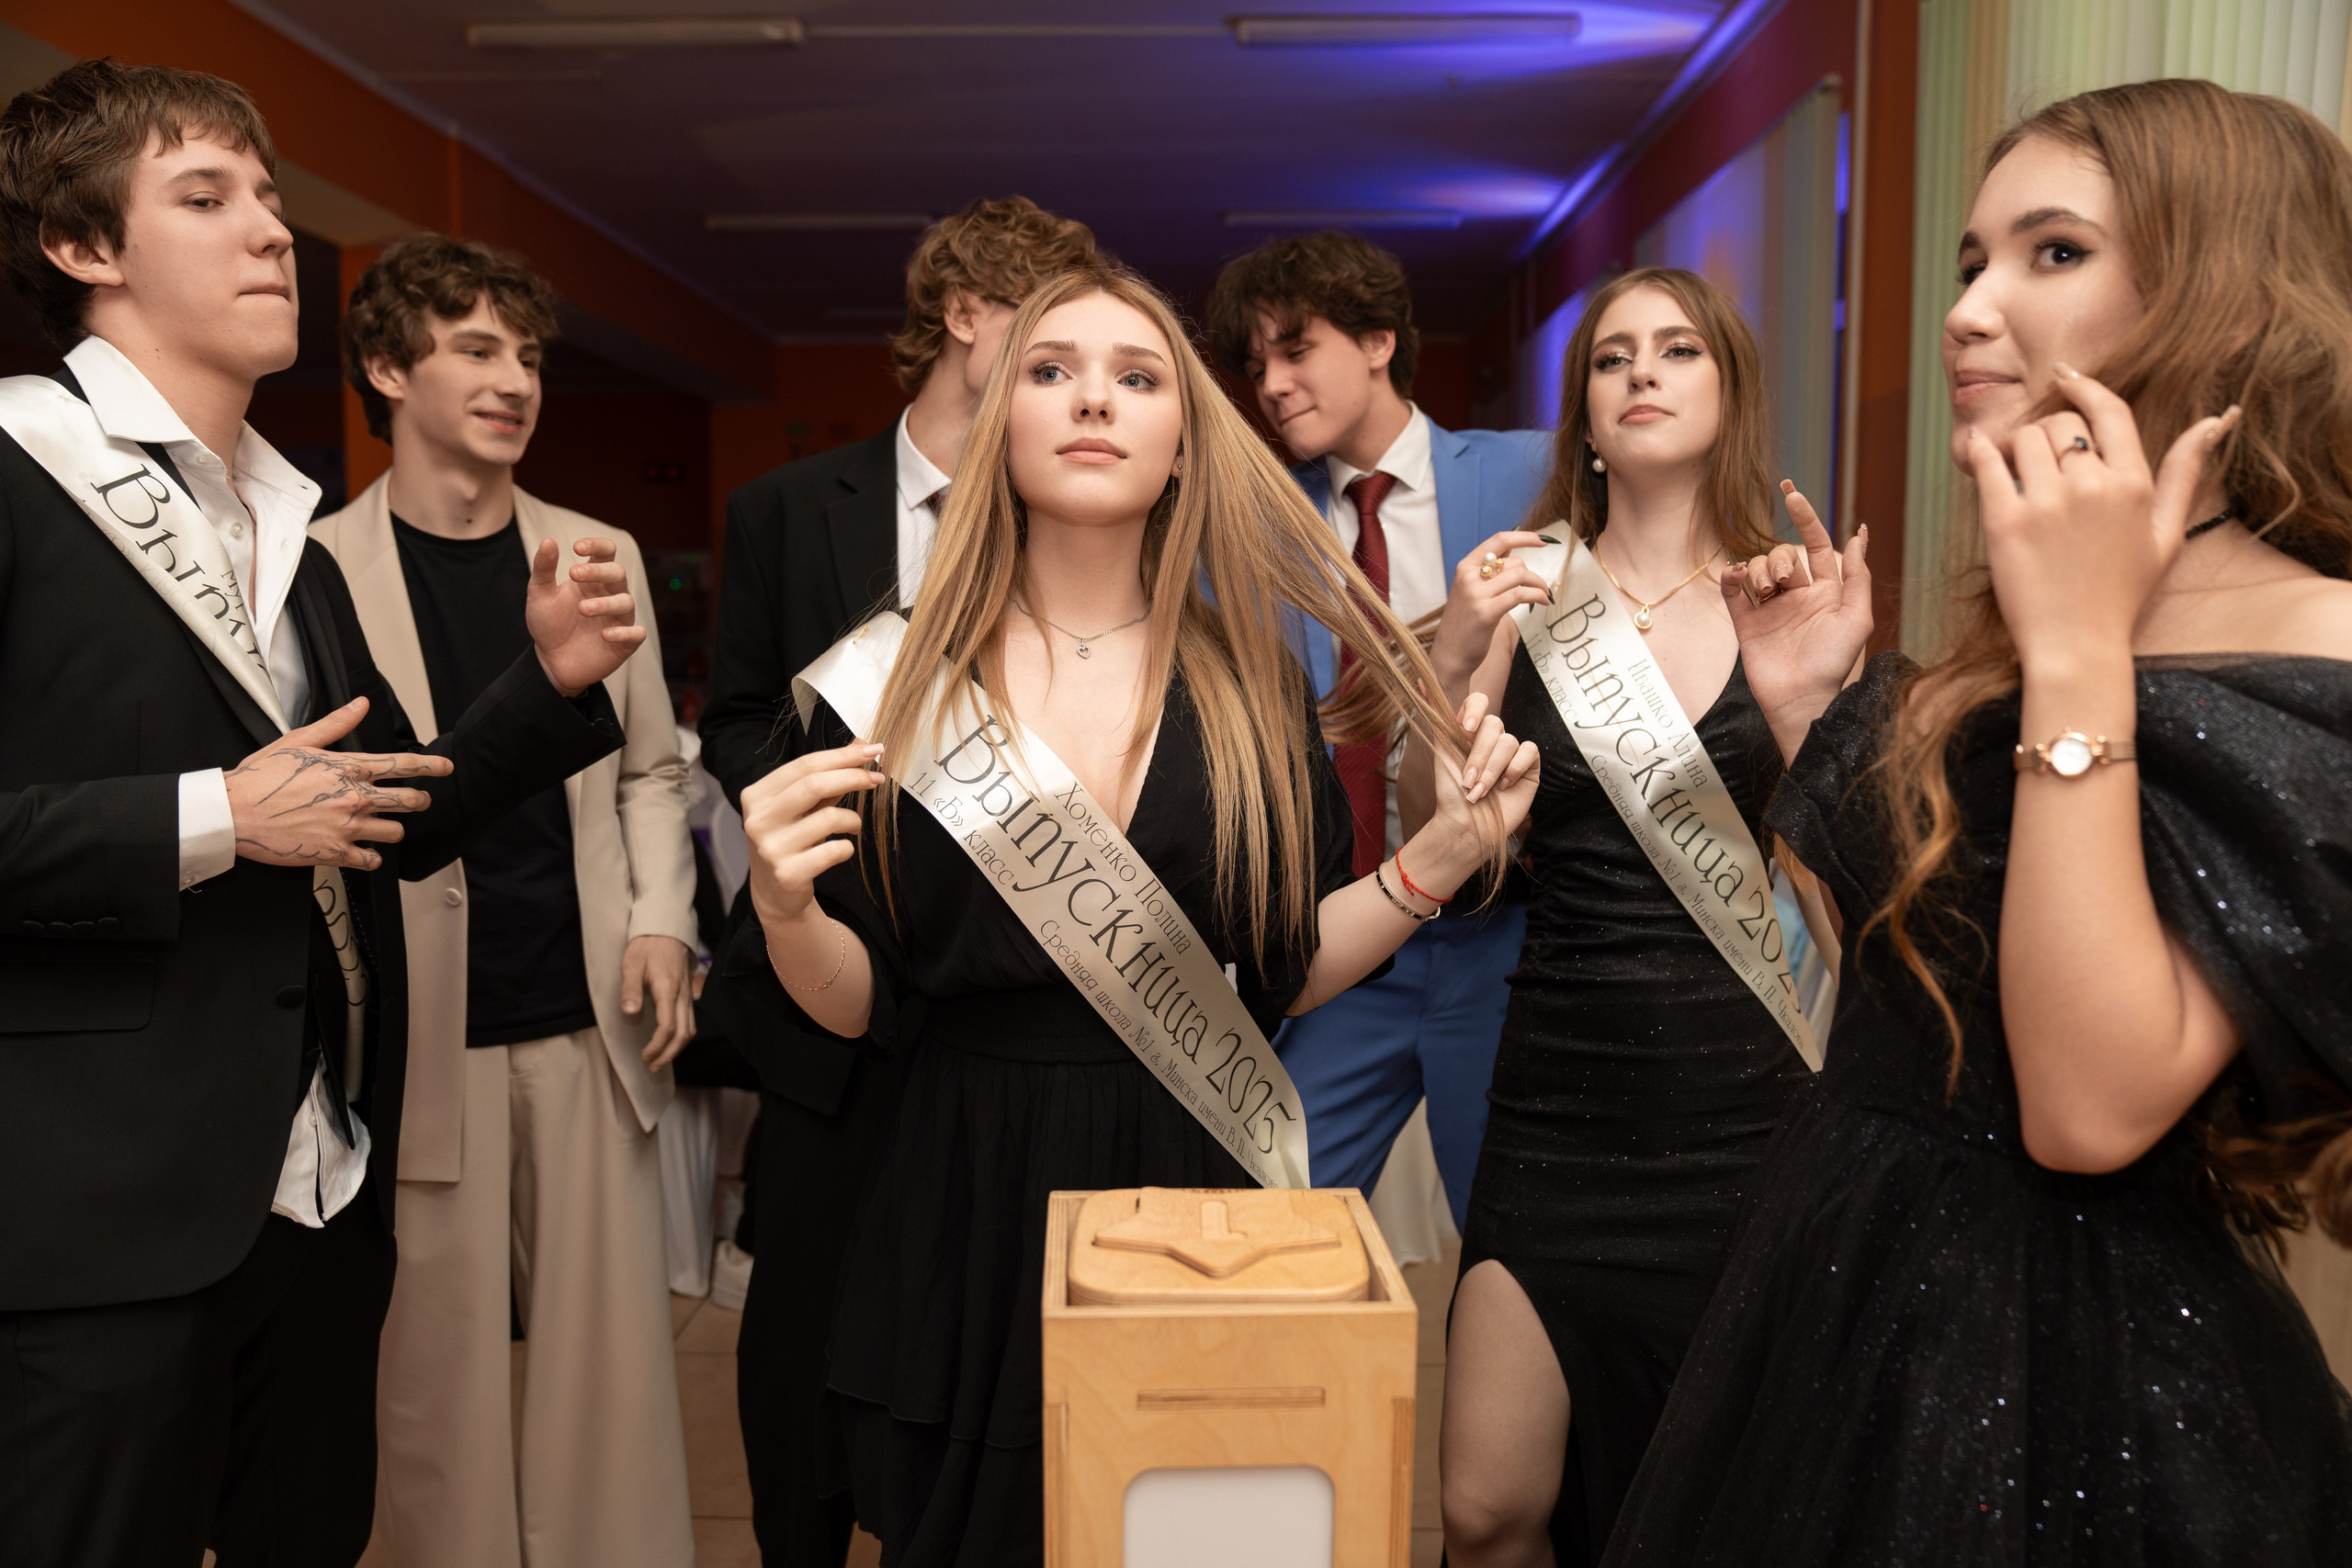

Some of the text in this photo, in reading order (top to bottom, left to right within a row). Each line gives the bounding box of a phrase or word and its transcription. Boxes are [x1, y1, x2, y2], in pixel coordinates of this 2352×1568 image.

[1545, 677, 1577, 722] класс
[1628, 659, 1708, 788] Ивашко Алина
[908, 772, 1014, 886] 11 «Б» класс
[1054, 781, 1192, 955] Хоменко Полина
[1545, 592, 1801, 1014] Выпускница 20
[1591, 755, 1634, 819] Средняя
[1631, 821, 1660, 859] школа
[1657, 858, 1681, 882] №1
[1687, 893, 1725, 941] Минска
[1723, 940, 1753, 976] имени
[1752, 971, 1766, 989] В.
[933, 714, 1297, 1154] Выпускница 2025
[1040, 919, 1099, 991] Средняя
[1094, 990, 1132, 1031] школа
[1128, 1026, 1155, 1054] №1
[1160, 1058, 1198, 1105] Минска
[1198, 1100, 1227, 1135] имени
[1226, 1126, 1236, 1147] В.
